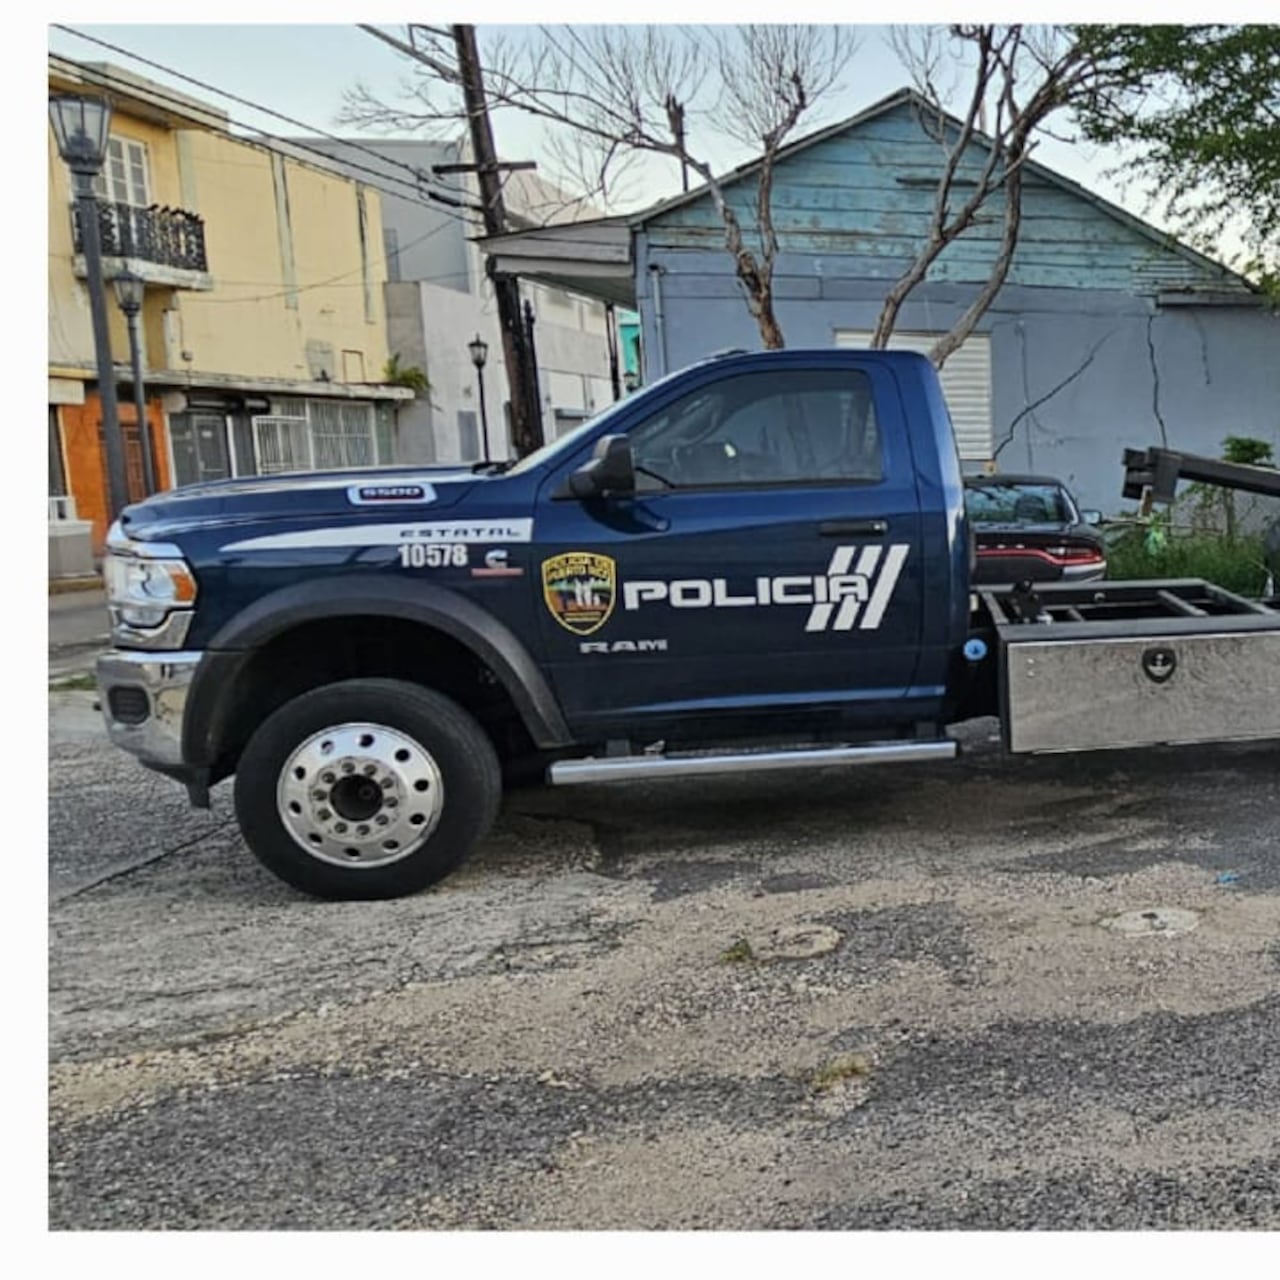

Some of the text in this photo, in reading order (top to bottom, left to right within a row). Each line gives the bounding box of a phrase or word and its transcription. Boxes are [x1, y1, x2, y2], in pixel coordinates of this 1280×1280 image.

[400, 527, 522, 538] ESTATAL
[398, 543, 468, 568] 10578
[623, 574, 869, 611] POLICIA
[579, 639, 668, 654] RAM
